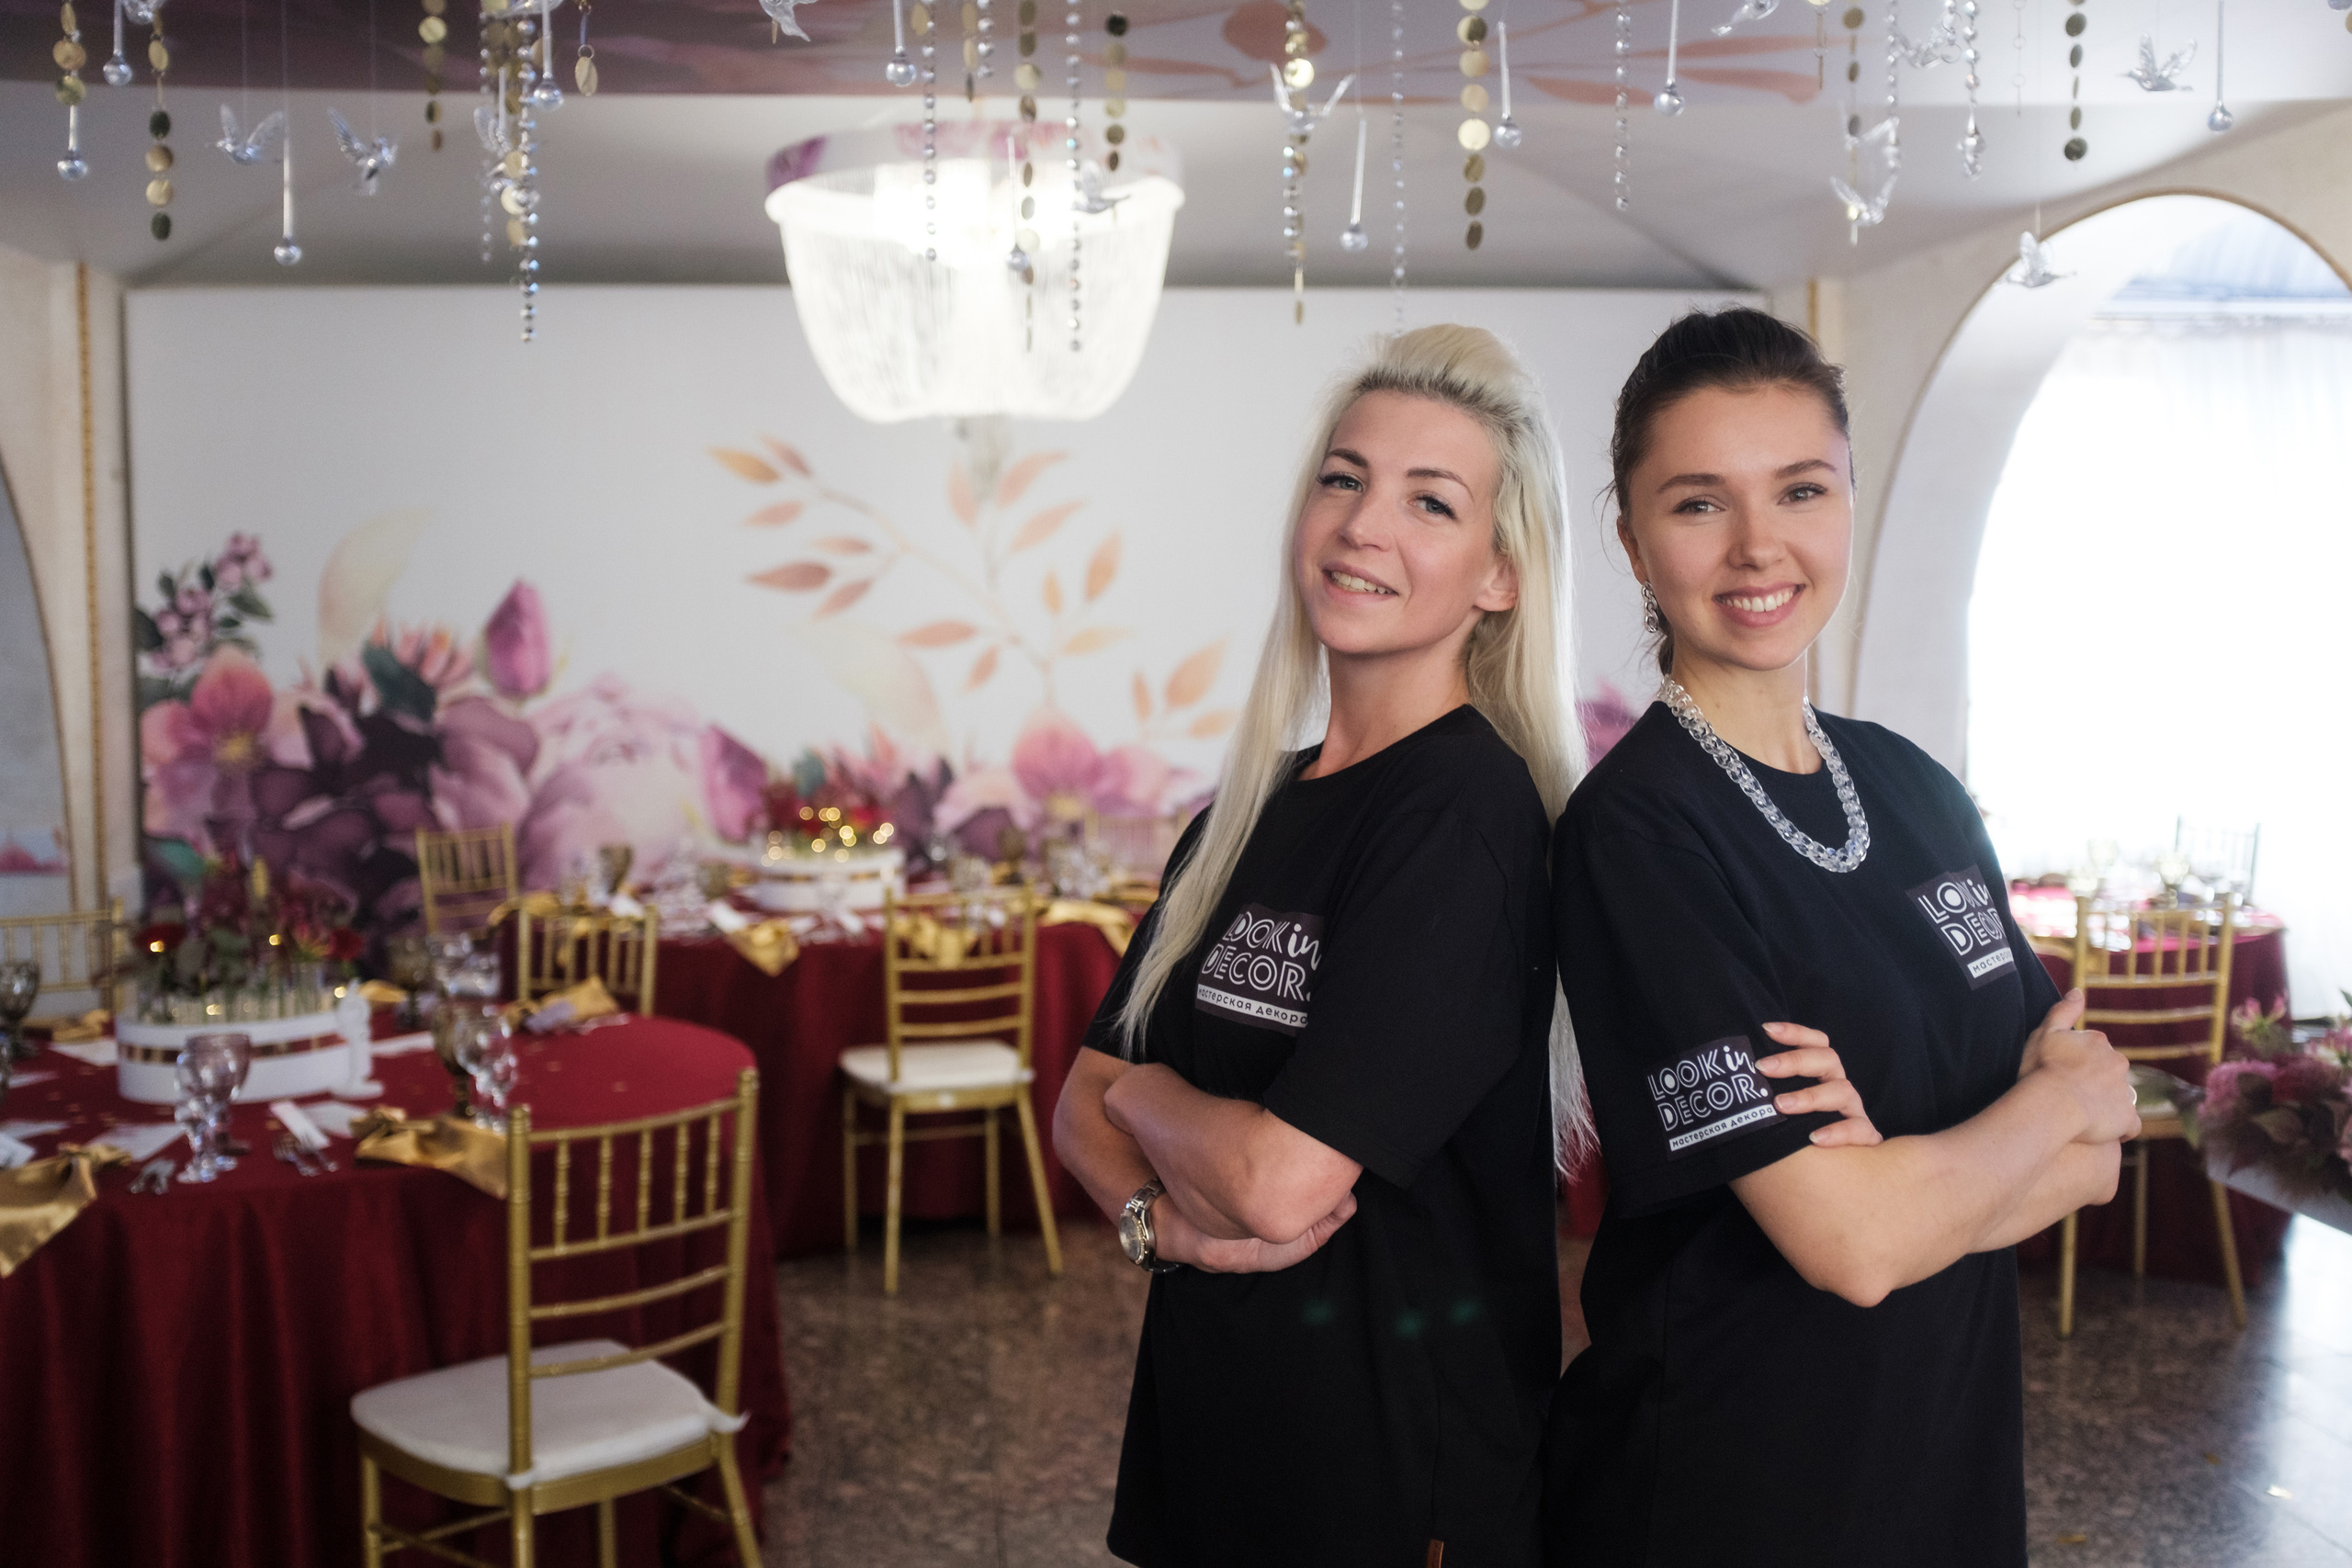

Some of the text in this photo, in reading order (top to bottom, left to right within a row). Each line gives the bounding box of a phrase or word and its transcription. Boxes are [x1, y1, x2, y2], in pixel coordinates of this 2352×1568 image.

[1287, 923, 1322, 971] in
[1255, 1005, 1308, 1025] декора
[1647, 1045, 1756, 1101] LOOK in
[1657, 1073, 1769, 1132] DECOR.
[1672, 1106, 1774, 1149] мастерская декора
